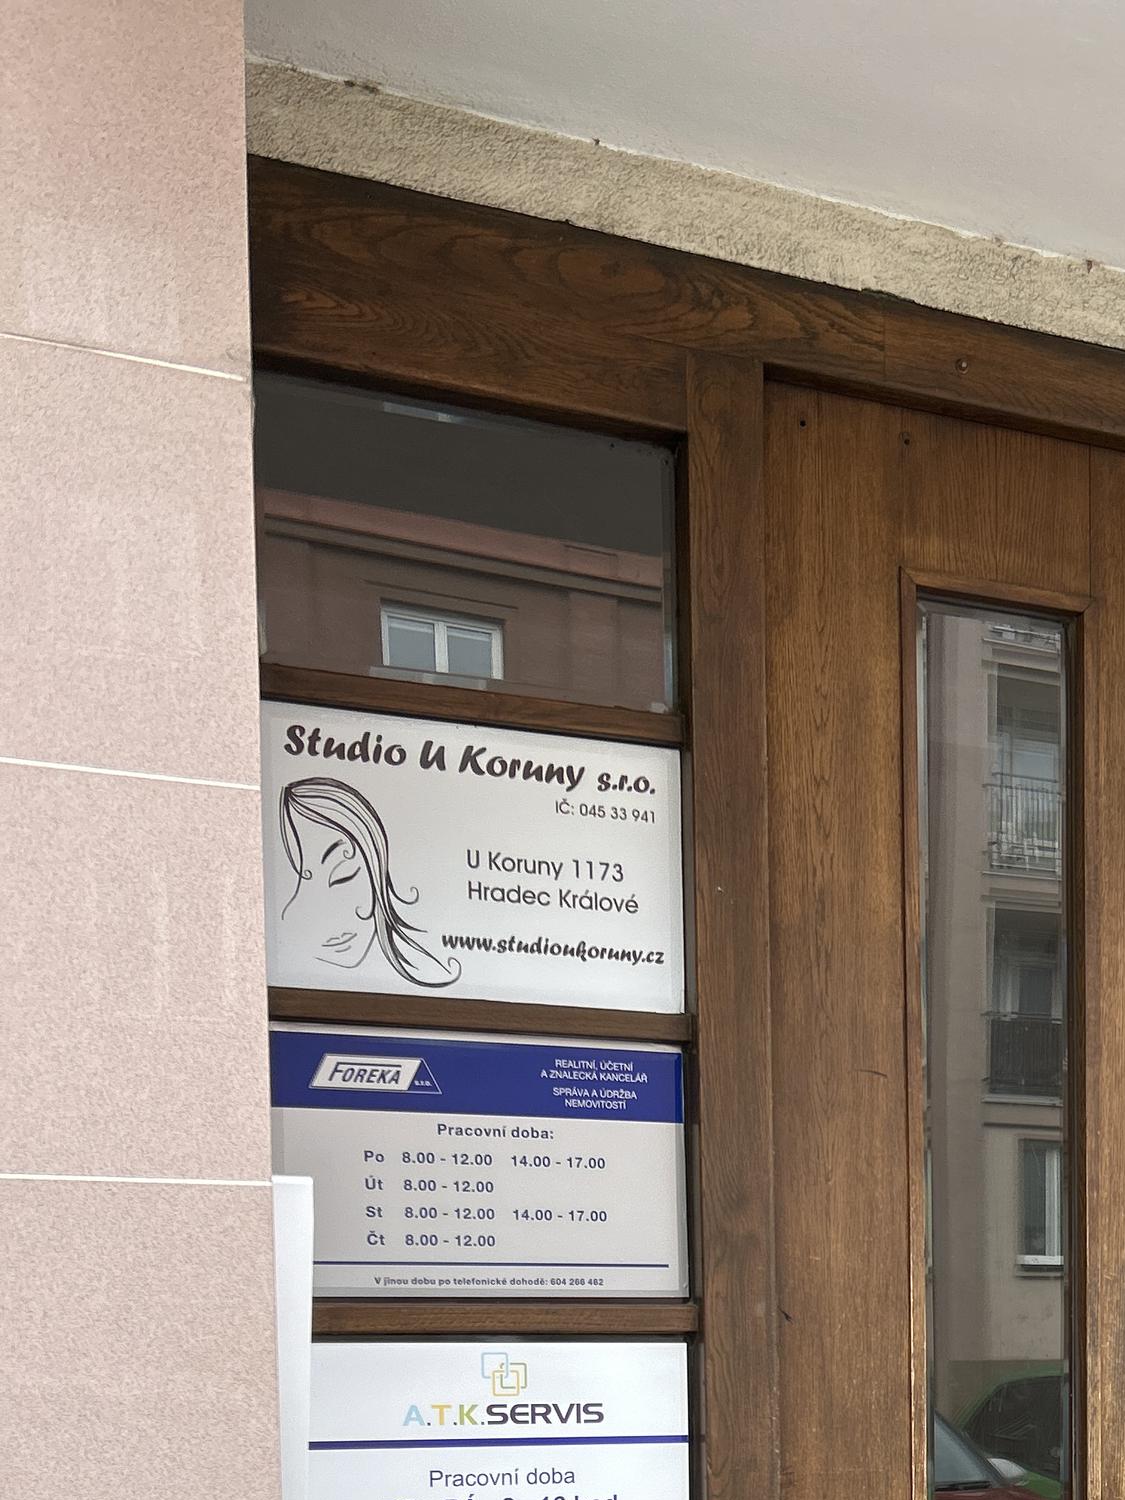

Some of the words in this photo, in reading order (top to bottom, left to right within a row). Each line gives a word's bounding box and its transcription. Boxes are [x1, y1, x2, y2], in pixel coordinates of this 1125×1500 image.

[284, 725, 407, 766] Studio
[420, 740, 447, 772] U
[458, 745, 586, 792] Koruny
[597, 770, 657, 795] s.r.o.
[555, 799, 575, 816] IČ:
[579, 803, 607, 819] 045
[610, 806, 629, 821] 33
[632, 808, 656, 824] 941
[466, 849, 481, 869] U
[488, 851, 564, 881] Koruny
[572, 858, 624, 882] 1173
[468, 881, 551, 907] Hradec
[559, 888, 639, 914] Králové
[441, 934, 665, 966] www.studioukoruny.cz
[328, 1061, 402, 1085] FOREKA
[600, 1060, 633, 1072] ÚČETNÍ
[540, 1069, 548, 1079] A
[600, 1073, 648, 1083] KANCELÁŘ
[553, 1086, 590, 1098] SPRÁVA
[591, 1089, 599, 1098] A
[600, 1088, 637, 1099] ÚDRŽBA
[564, 1098, 626, 1110] NEMOVITOSTÍ
[437, 1123, 507, 1138] Pracovní
[511, 1126, 554, 1140] doba:
[364, 1150, 384, 1163] Po
[402, 1151, 435, 1164] 8.00
[452, 1153, 493, 1166] 12.00
[511, 1155, 551, 1168] 14.00
[567, 1157, 606, 1169] 17.00
[365, 1175, 384, 1190] Út
[403, 1179, 436, 1191] 8.00
[453, 1180, 494, 1193] 12.00
[365, 1205, 383, 1218] St
[404, 1206, 437, 1219] 8.00
[454, 1207, 495, 1220] 12.00
[513, 1209, 552, 1221] 14.00
[569, 1210, 608, 1222] 17.00
[367, 1230, 385, 1246] Čt
[405, 1234, 438, 1246] 8.00
[455, 1235, 496, 1247] 12.00
[374, 1277, 382, 1285] V
[383, 1276, 408, 1286] jinou
[411, 1277, 436, 1285] dobu
[438, 1278, 451, 1287] po
[453, 1277, 507, 1286] telefonické
[509, 1277, 548, 1286] dohodě:
[429, 1468, 519, 1487] Pracovní
[526, 1467, 576, 1486] doba
